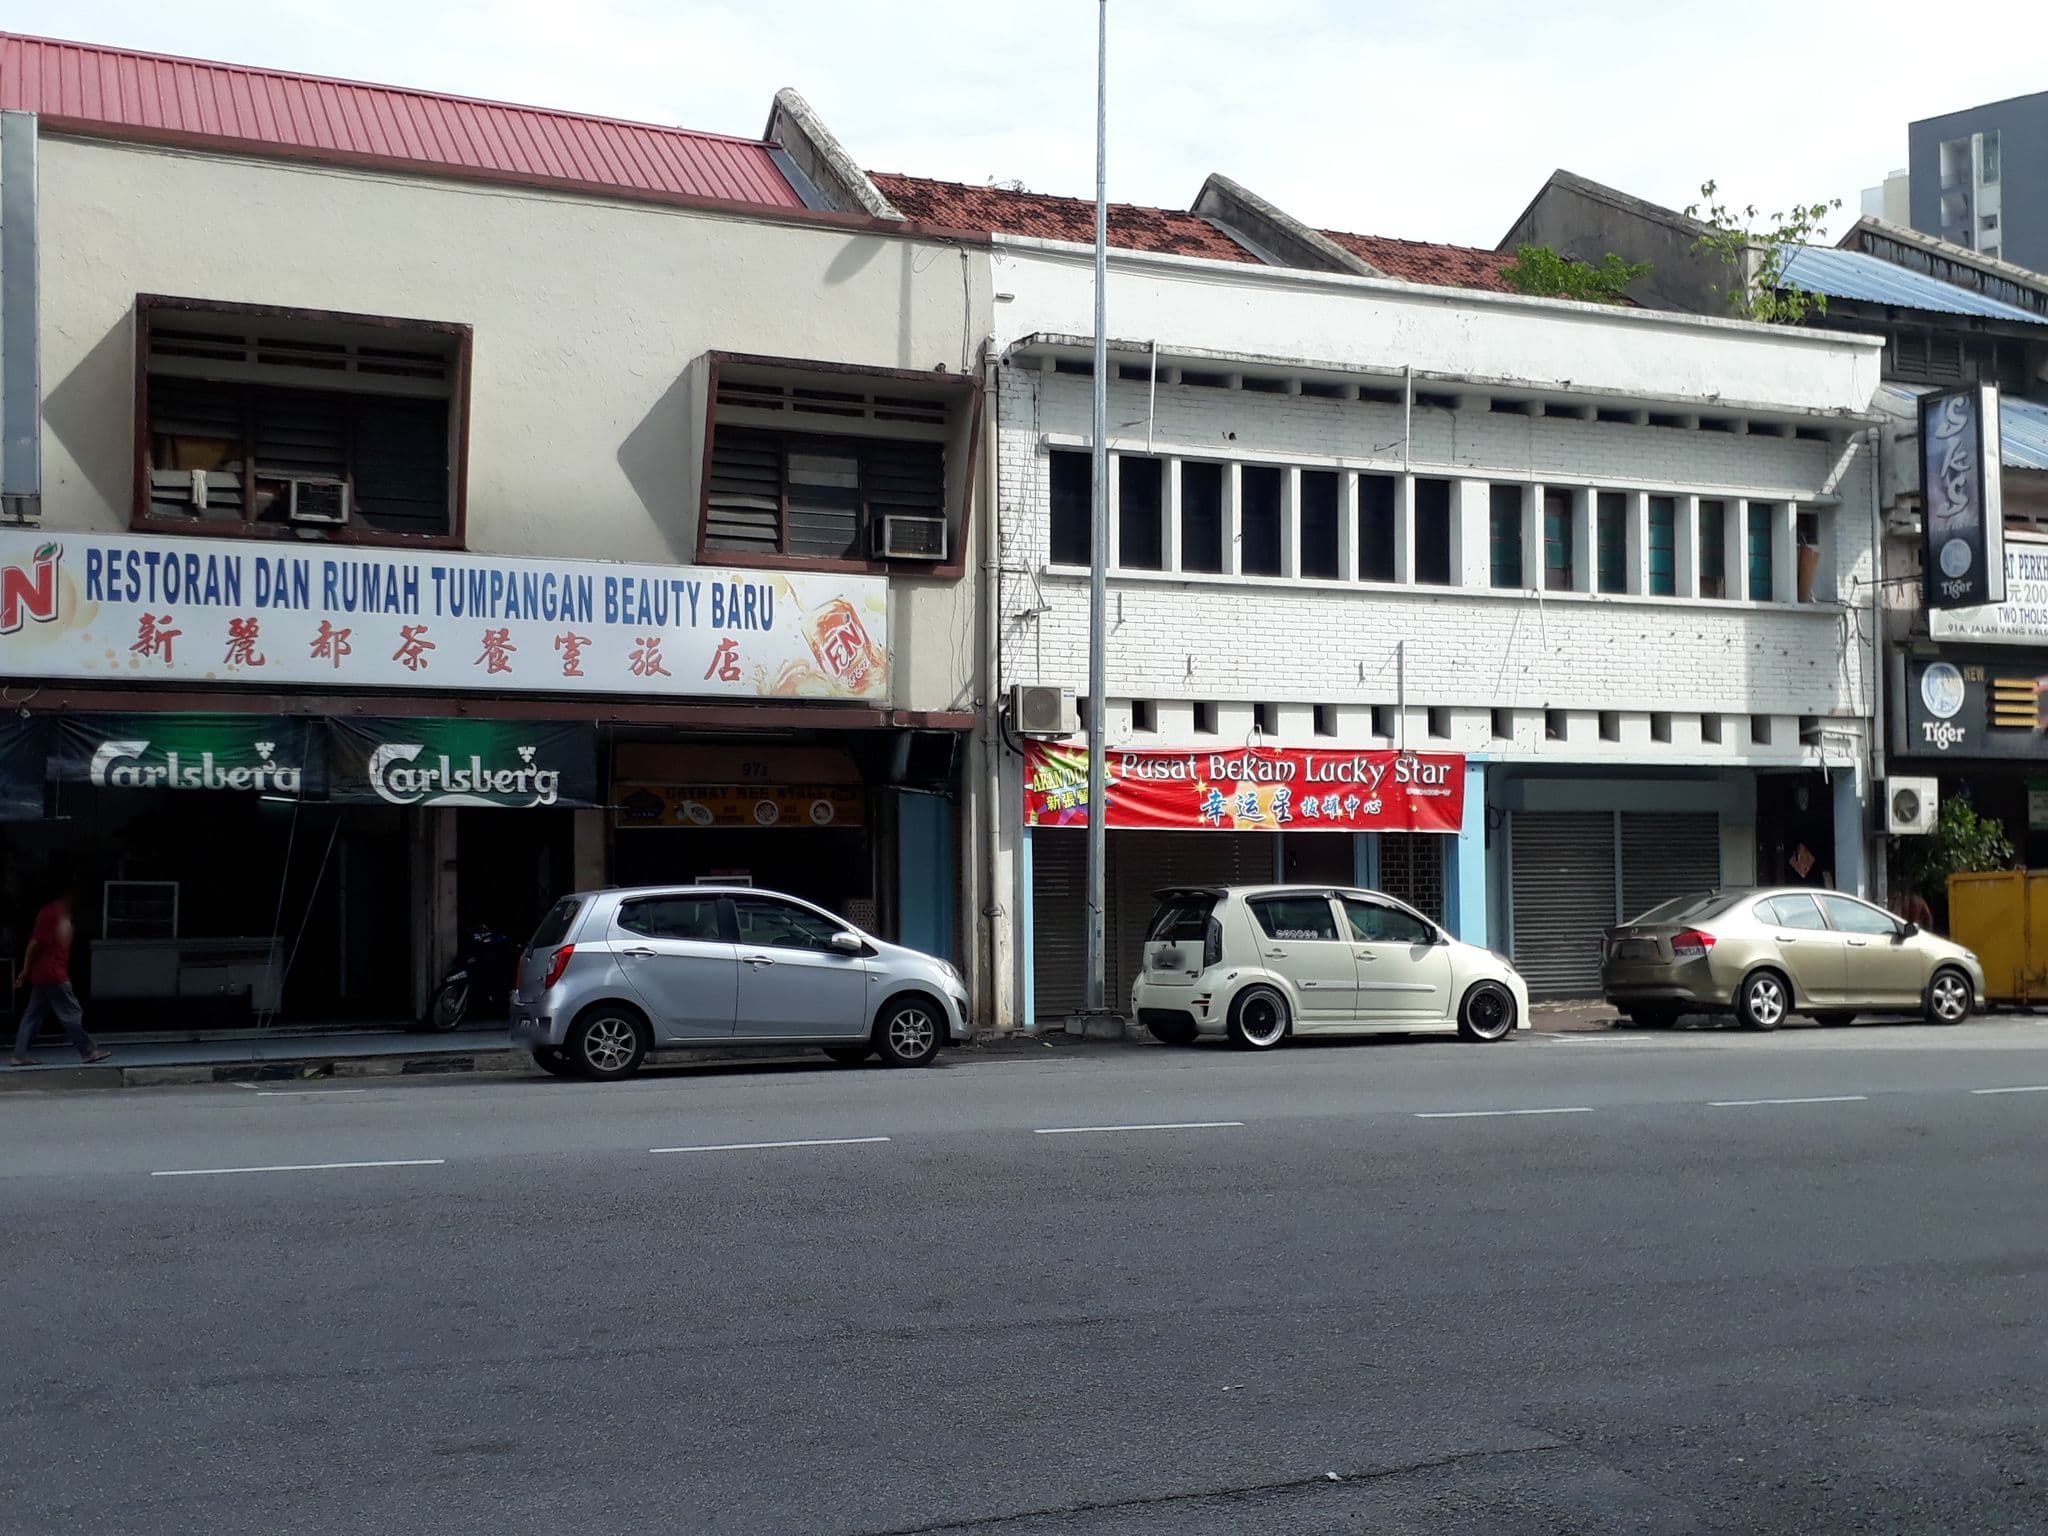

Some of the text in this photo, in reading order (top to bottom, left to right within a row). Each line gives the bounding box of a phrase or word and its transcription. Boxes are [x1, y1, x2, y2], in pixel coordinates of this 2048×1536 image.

[87, 548, 774, 632] RESTORAN DAN RUMAH TUMPANGAN BEAUTY BARU
[1941, 580, 1973, 599] Tiger
[1997, 606, 2018, 624] TWO
[1970, 624, 1998, 635] JALAN
[2000, 626, 2025, 636] YANG
[1922, 721, 1966, 750] Tiger
[368, 743, 561, 806] Carlsberg
[1120, 752, 1452, 791] Pusat Bekam Lucky Star
